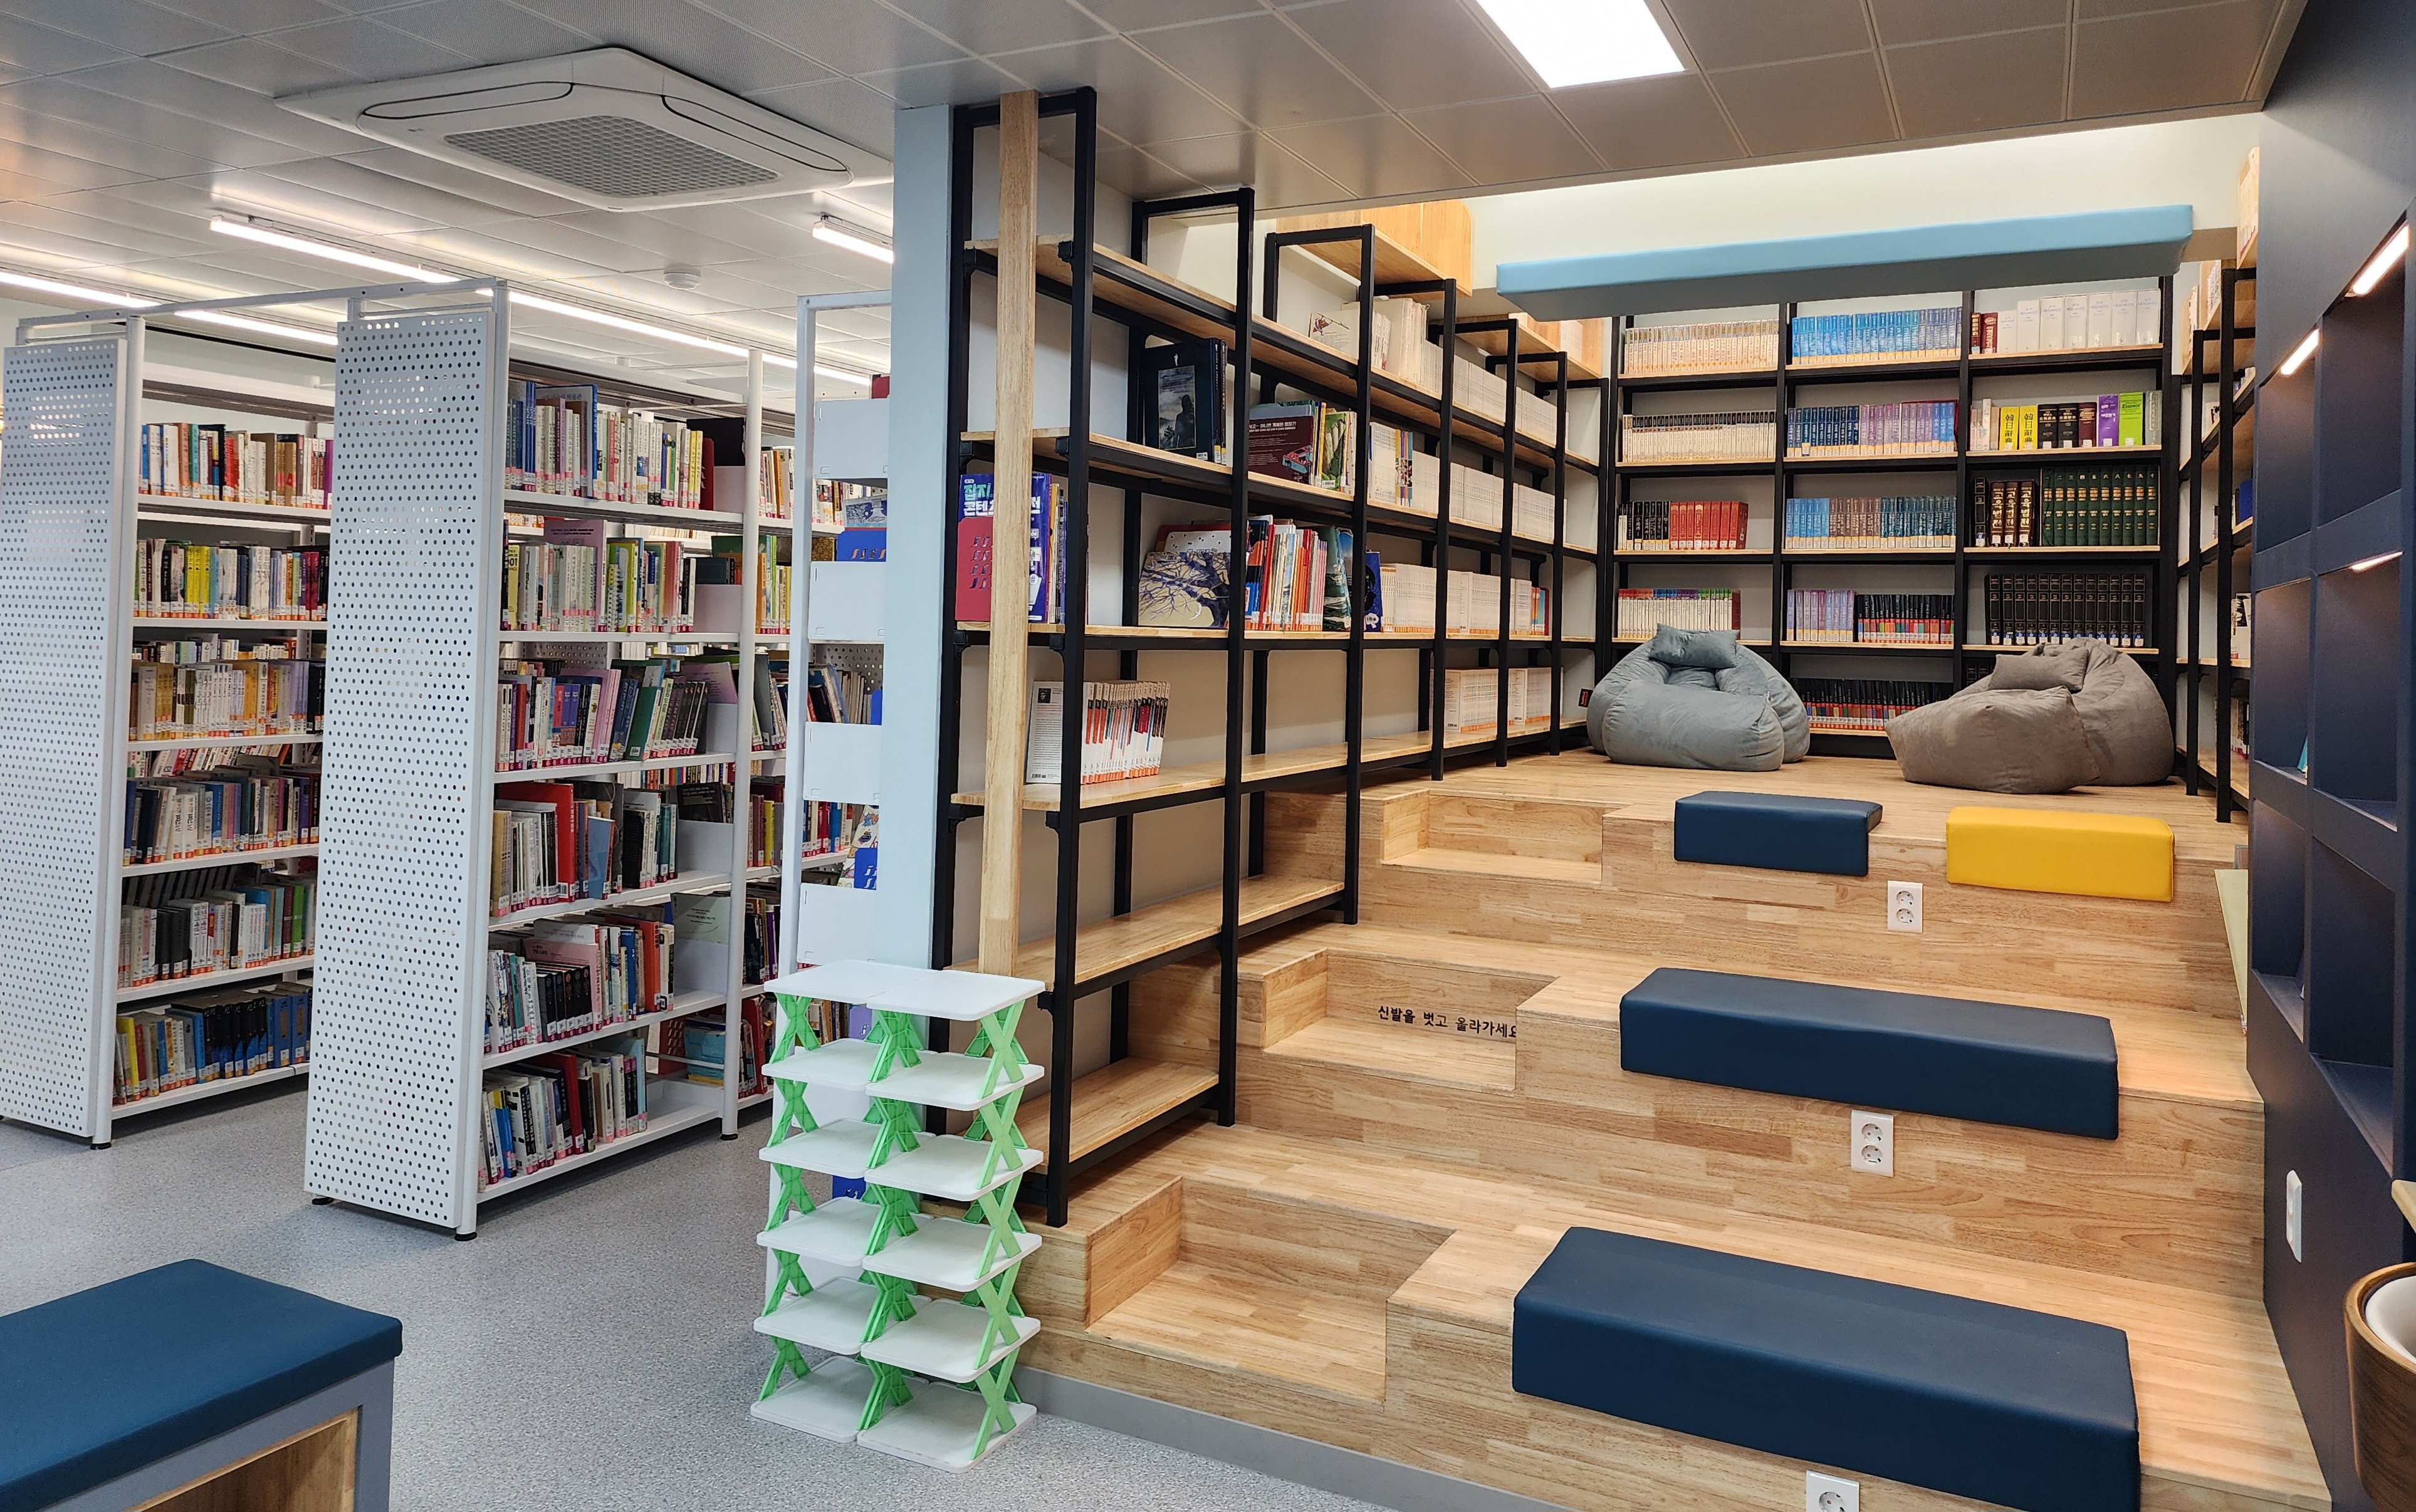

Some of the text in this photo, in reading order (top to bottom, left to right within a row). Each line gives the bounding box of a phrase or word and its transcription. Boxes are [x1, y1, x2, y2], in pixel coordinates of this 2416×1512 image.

[964, 483, 991, 501] 잡지
[2020, 490, 2031, 528] 교육법전
[1378, 1005, 1415, 1024] 신발을
[1423, 1011, 1448, 1028] 벗고
